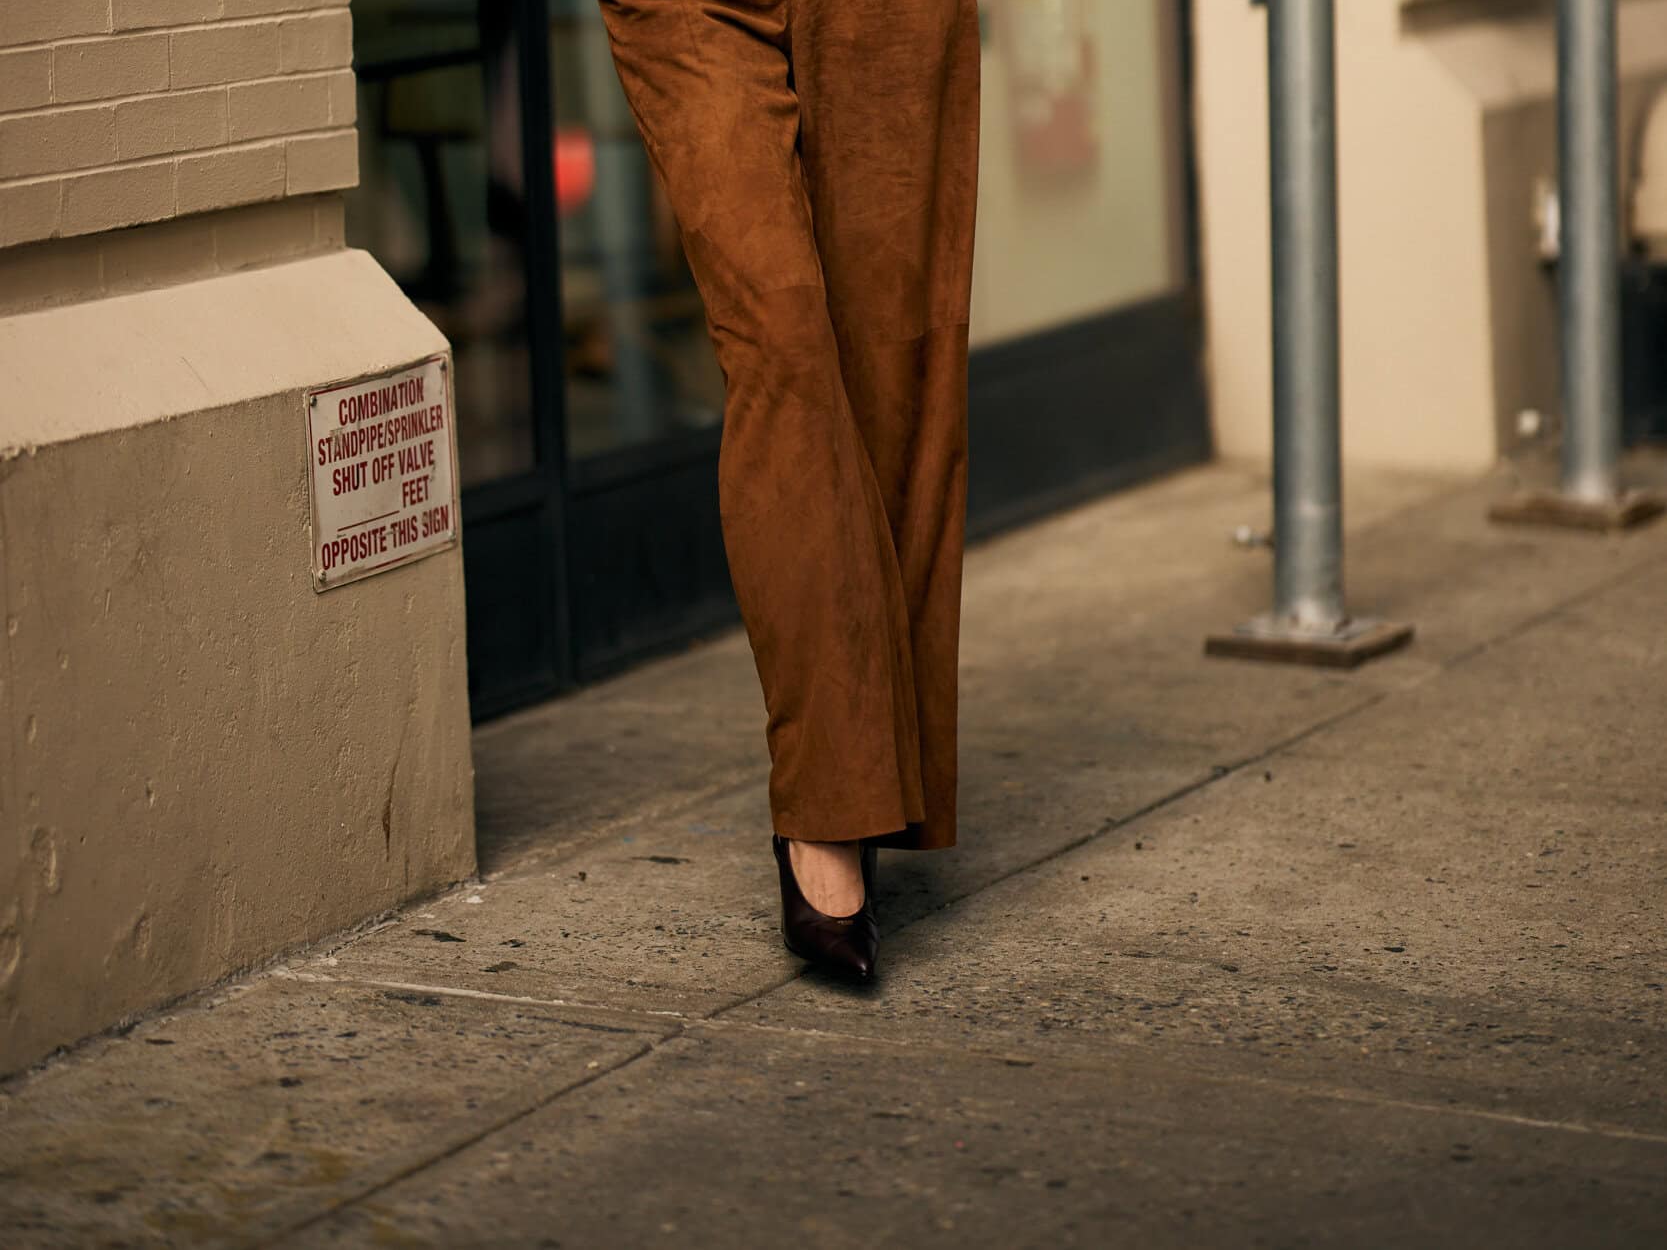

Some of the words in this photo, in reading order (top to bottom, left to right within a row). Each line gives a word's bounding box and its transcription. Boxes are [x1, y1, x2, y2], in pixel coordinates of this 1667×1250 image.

[339, 377, 424, 425] COMBINATION
[319, 405, 443, 465] STANDPIPE/SPRINKLER
[333, 462, 367, 495] SHUT
[373, 453, 395, 484] OFF
[399, 441, 434, 475] VALVE
[403, 476, 429, 507] FEET
[322, 524, 387, 570] OPPOSITE
[391, 516, 418, 548] THIS
[422, 506, 448, 538] SIGN
